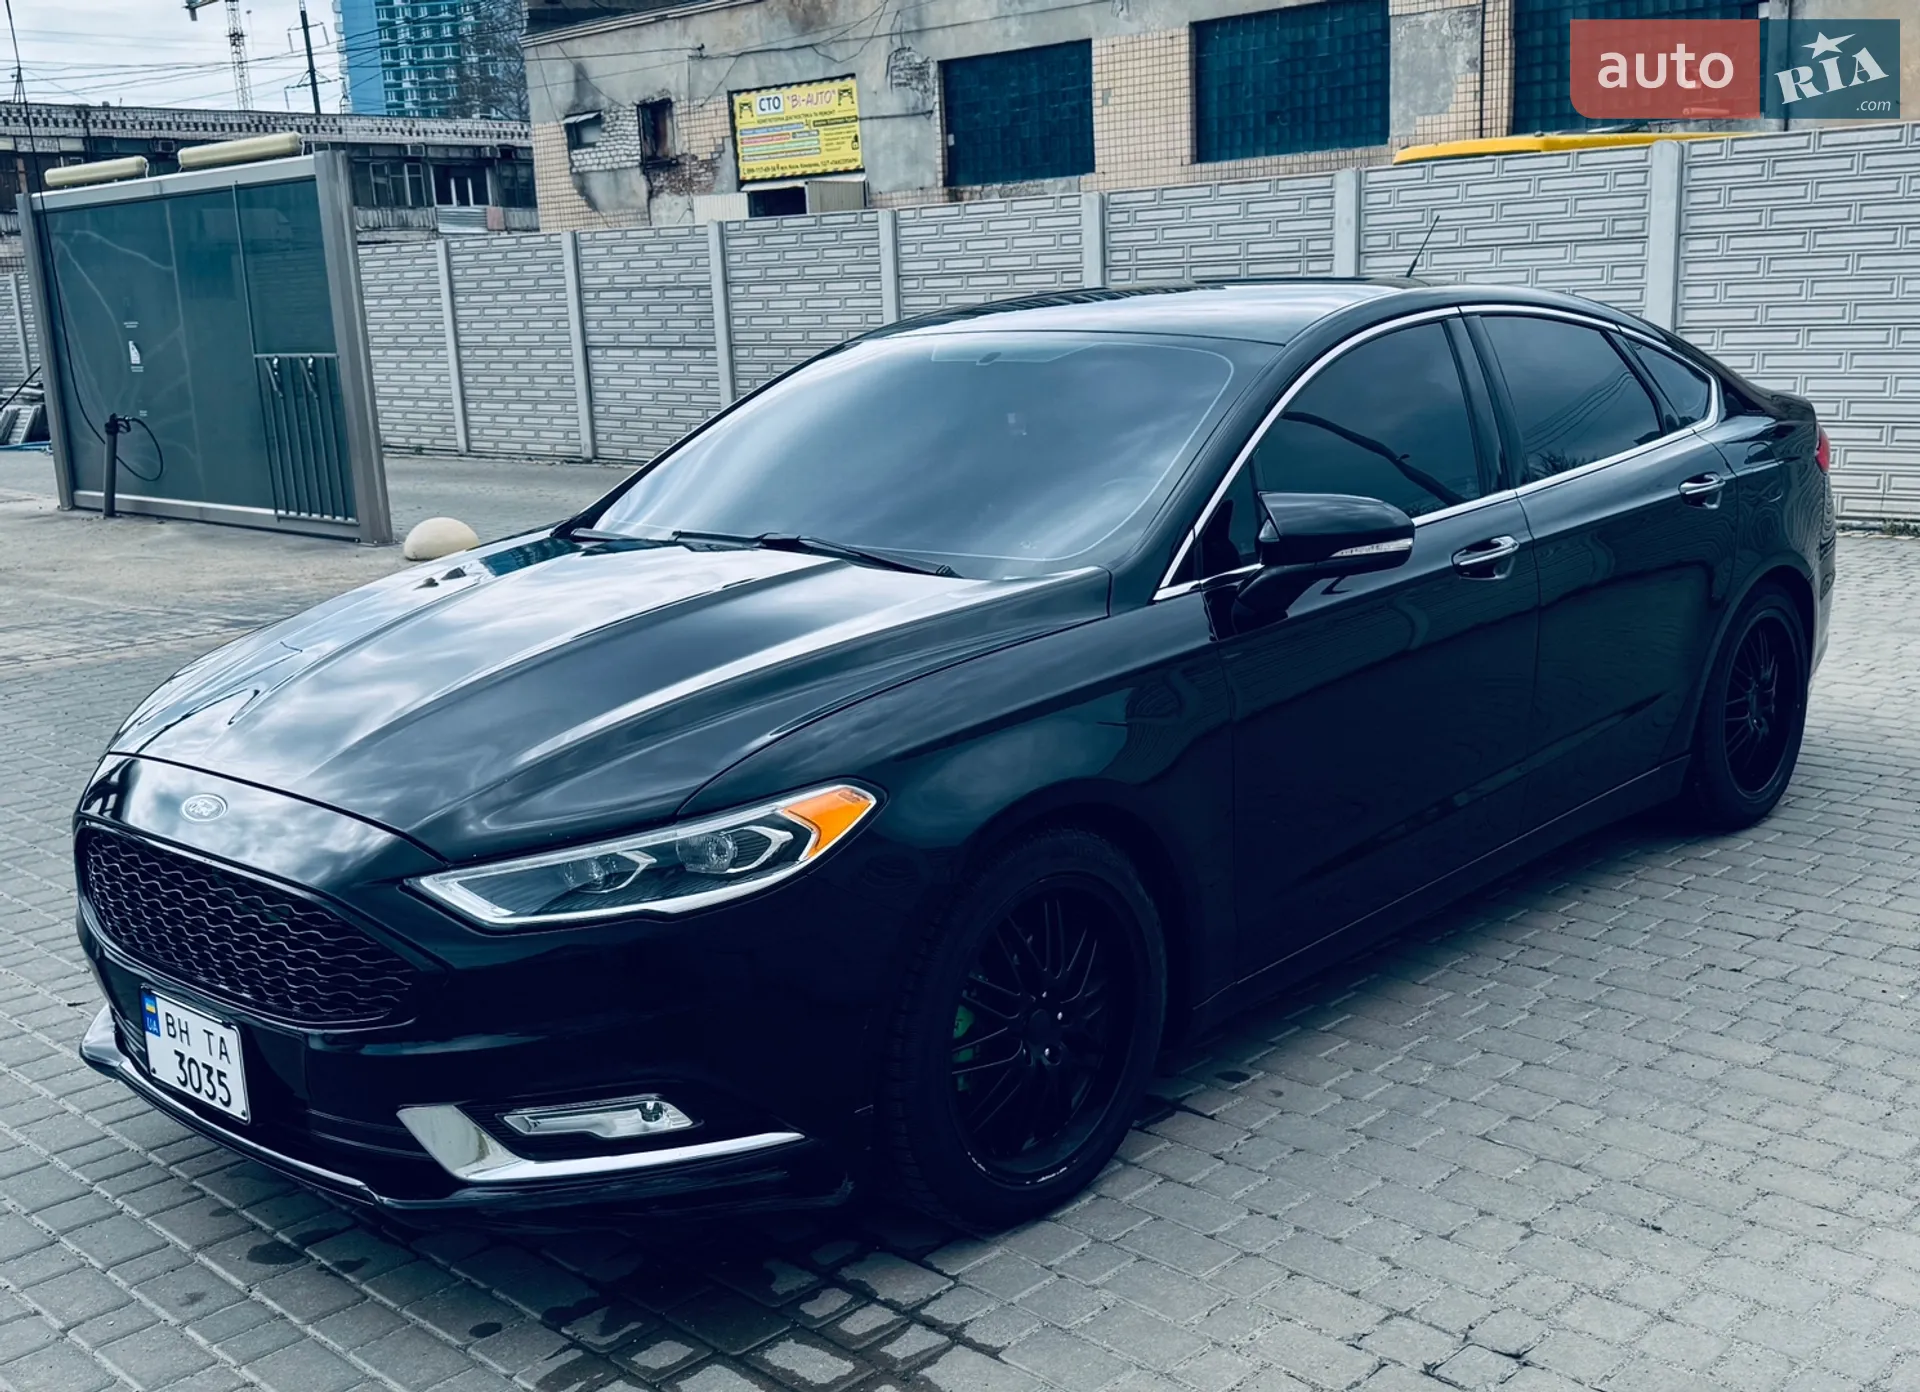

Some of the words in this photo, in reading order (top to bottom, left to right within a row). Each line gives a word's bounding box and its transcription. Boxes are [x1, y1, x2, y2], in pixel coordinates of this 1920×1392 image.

[758, 96, 781, 111] СТО
[146, 1018, 159, 1034] UA
[165, 1012, 191, 1046] BH
[203, 1029, 231, 1065] TA
[174, 1049, 232, 1108] 3035
